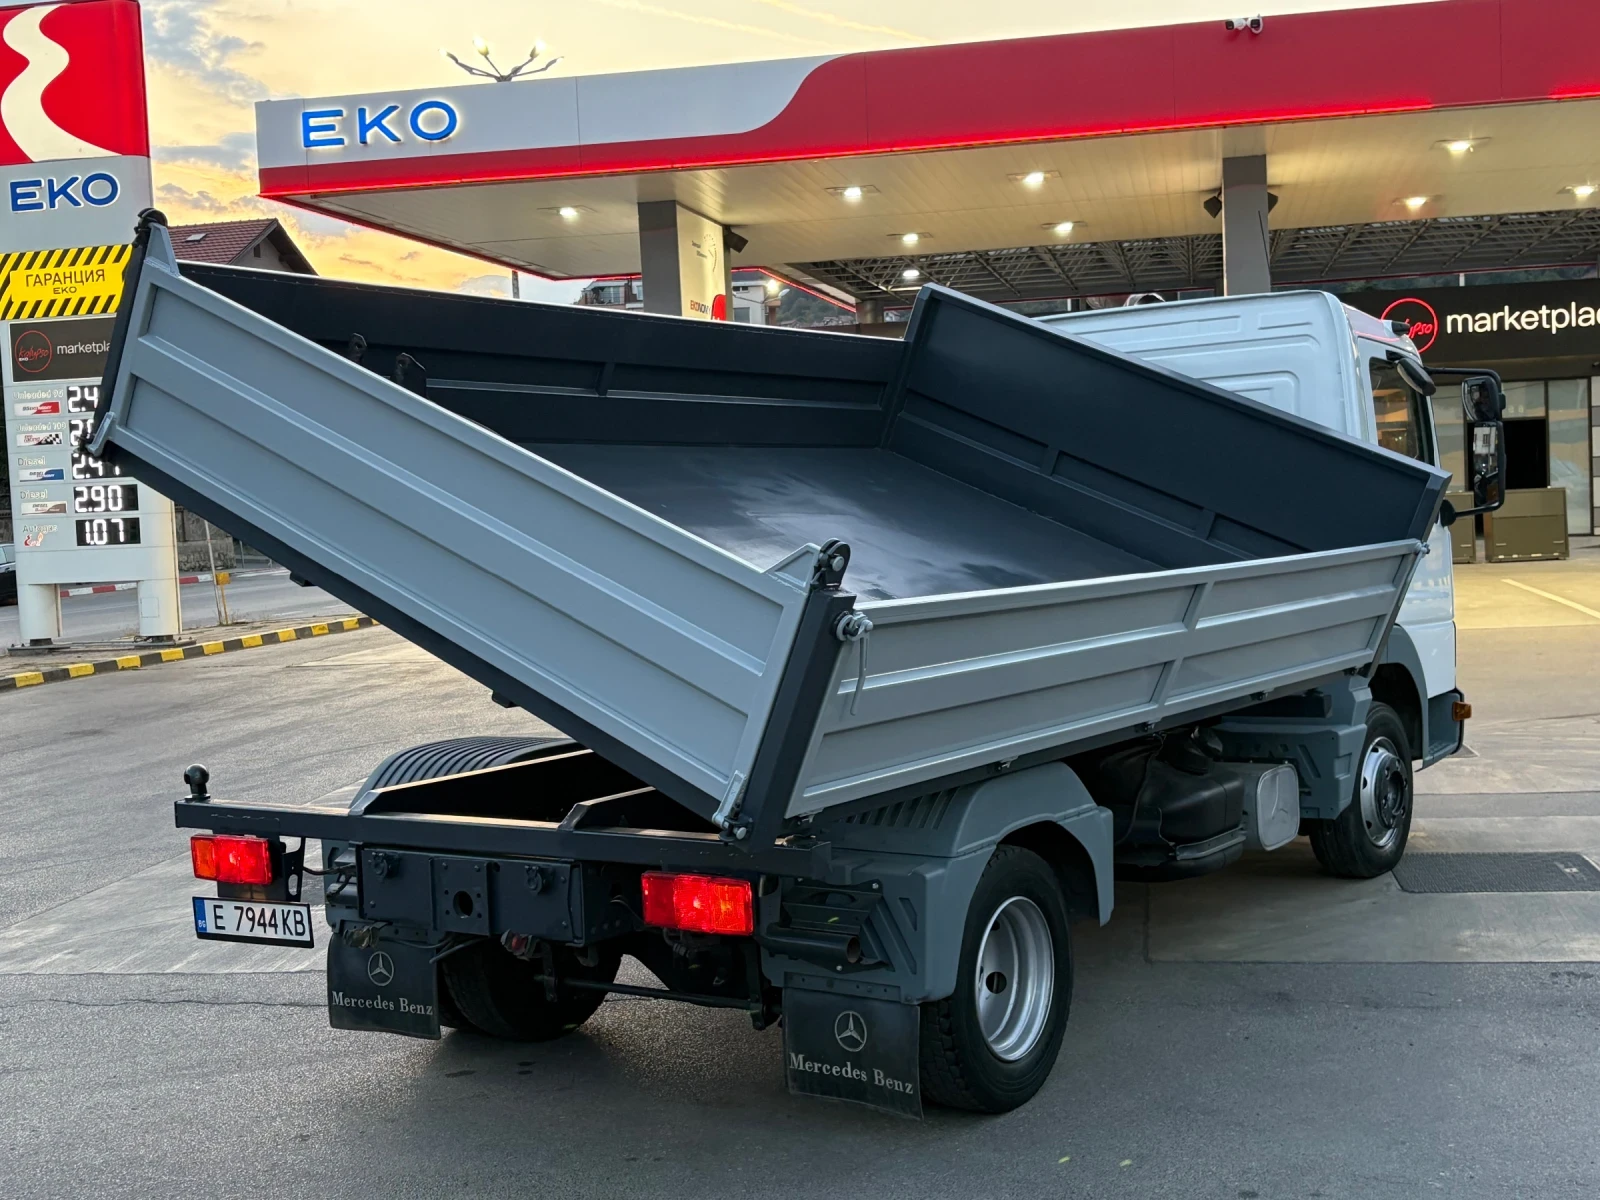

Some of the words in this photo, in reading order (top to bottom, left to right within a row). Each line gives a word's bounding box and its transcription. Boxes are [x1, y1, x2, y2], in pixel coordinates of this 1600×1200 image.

[302, 100, 458, 148] EKO
[10, 172, 119, 212] EKO
[25, 268, 106, 287] ГАРАНЦИЯ
[53, 286, 77, 295] EKO
[1446, 301, 1600, 335] marketpla
[17, 455, 46, 466] Diesel
[20, 488, 48, 500] Diesel
[74, 485, 123, 512] 2.90
[85, 518, 125, 545] 1.07
[213, 904, 226, 930] E
[332, 990, 395, 1011] Mercedes
[399, 997, 434, 1016] Benz
[789, 1052, 868, 1081] Mercedes
[872, 1068, 914, 1095] Benz
